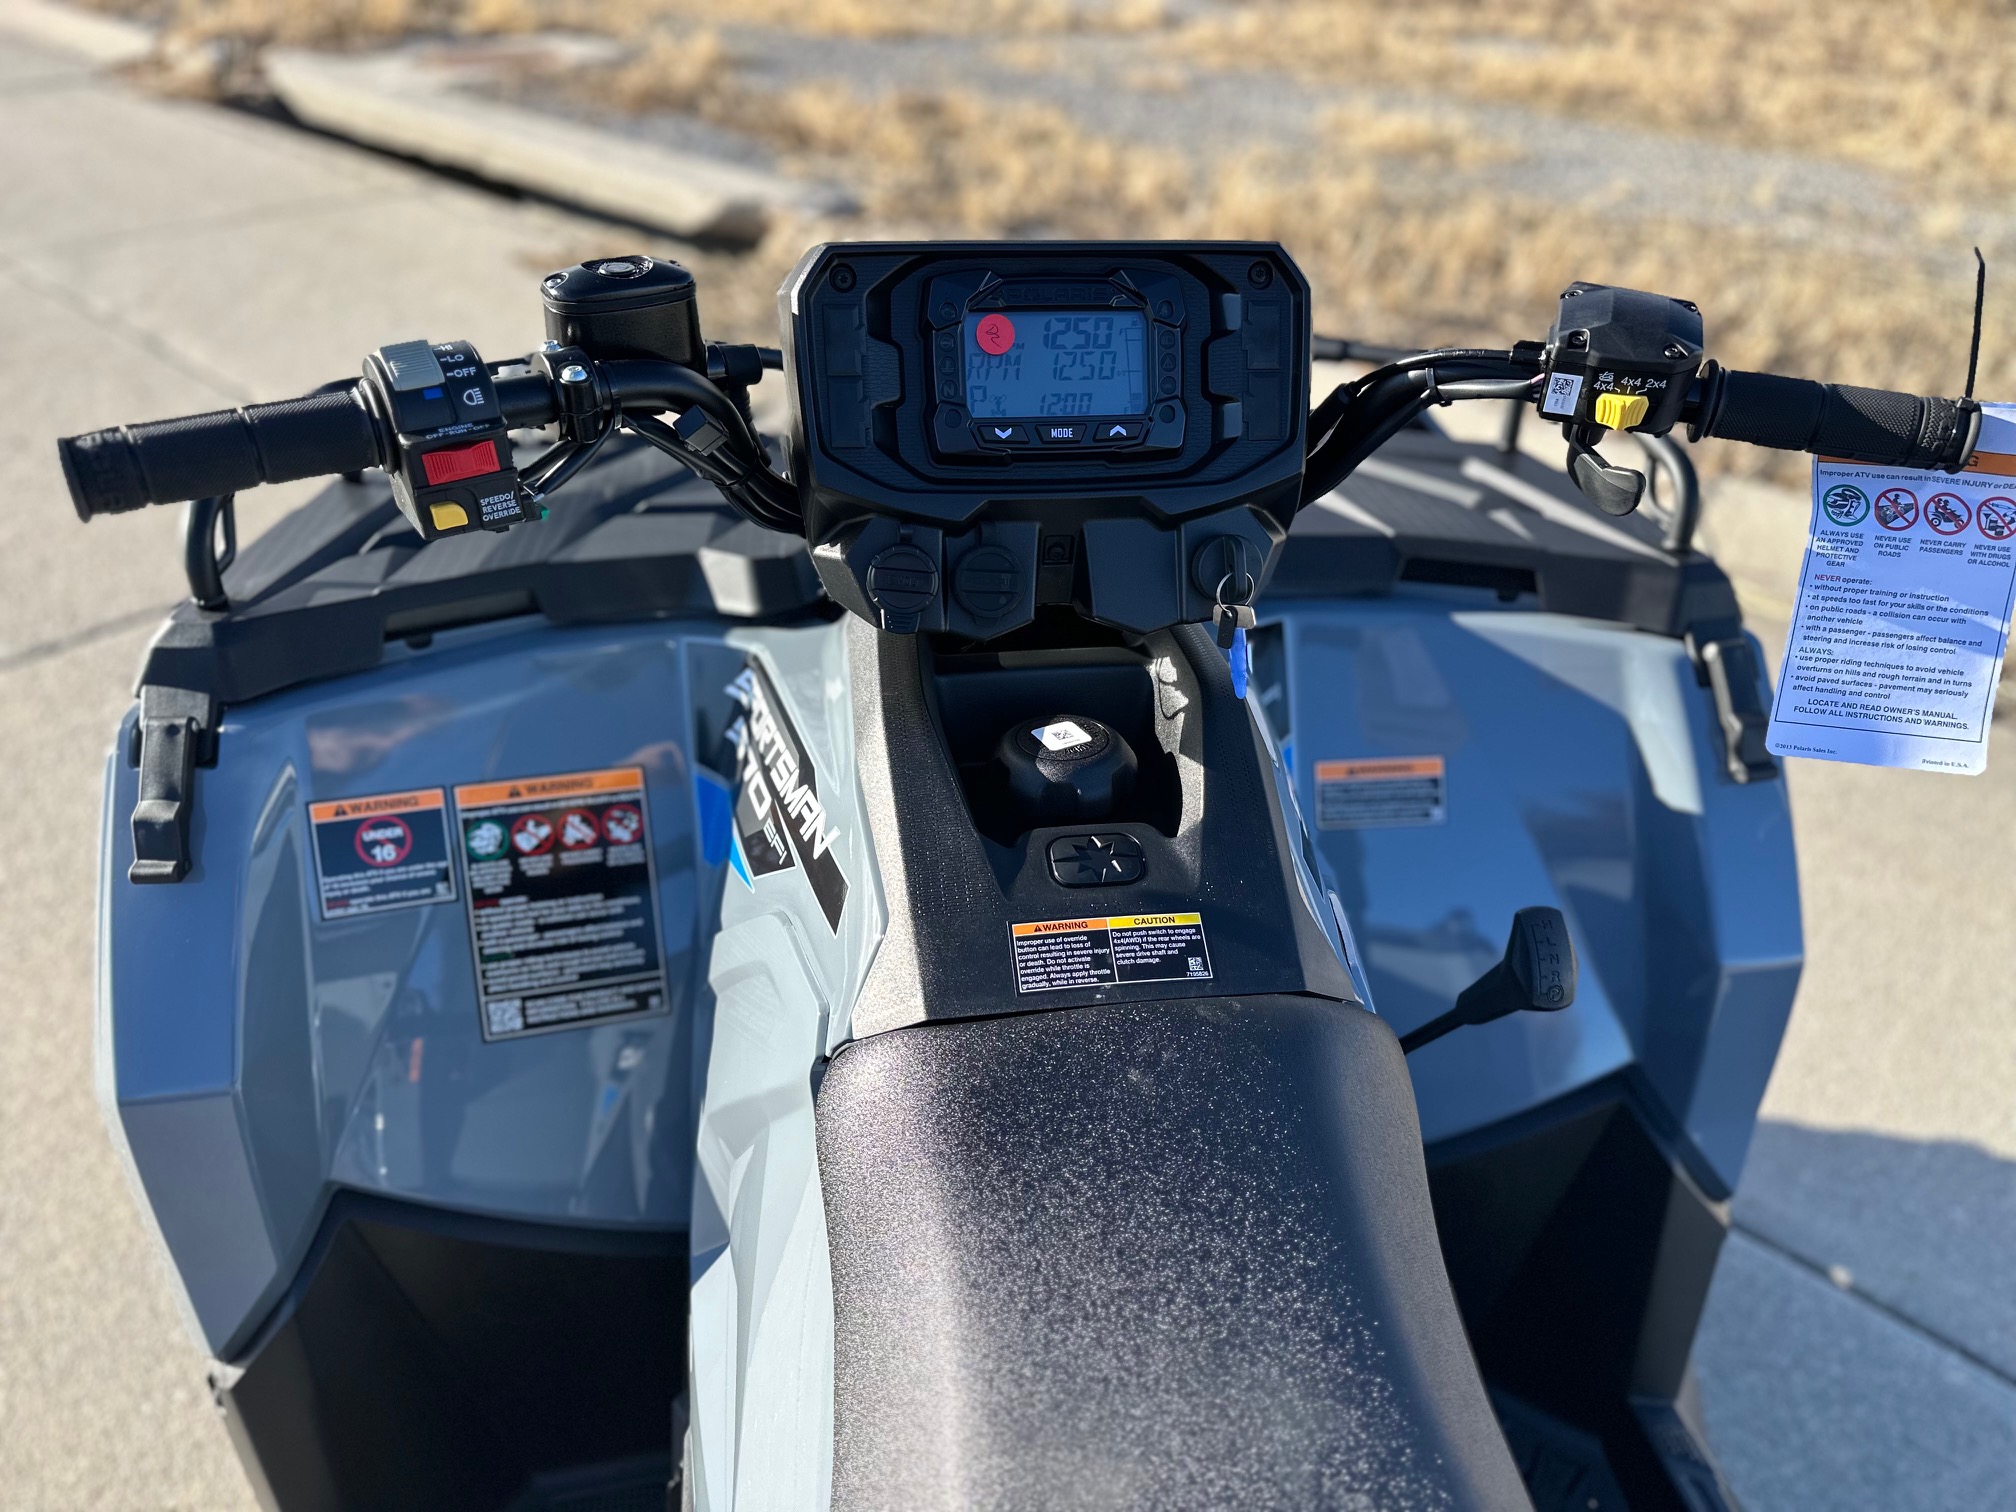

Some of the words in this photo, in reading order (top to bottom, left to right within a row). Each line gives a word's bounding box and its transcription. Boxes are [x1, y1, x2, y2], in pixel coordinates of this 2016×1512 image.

[1043, 317, 1114, 350] 1250
[967, 352, 1022, 381] RPM
[1053, 351, 1116, 380] 1250
[438, 423, 473, 433] ENGINE
[1051, 428, 1073, 438] MODE
[1932, 476, 1961, 485] SEVERE
[1962, 479, 1993, 488] INJURY
[480, 490, 514, 506] SPEEDO/
[482, 500, 517, 514] REVERSE
[482, 506, 521, 521] OVERRIDE
[1814, 574, 1841, 582] NEVER
[1869, 589, 1898, 599] training
[1909, 592, 1949, 602] instruction
[1879, 611, 1910, 619] collision
[1949, 608, 1989, 616] conditions
[1828, 627, 1866, 636] passenger
[1872, 632, 1914, 640] passengers
[1938, 636, 1966, 645] balance
[1798, 646, 1834, 656] ALWAYS:
[1840, 658, 1862, 668] riding
[1864, 661, 1904, 670] techniques
[1878, 684, 1916, 692] pavement
[1934, 689, 1969, 698] seriously
[1808, 698, 1839, 708] LOCATE
[1859, 704, 1882, 712] READ
[1883, 706, 1920, 716] OWNER'S
[1922, 710, 1958, 720] MANUAL.
[1794, 706, 1827, 715] FOLLOW
[1845, 711, 1903, 723] INSTRUCTIONS
[1924, 719, 1969, 730] WARNINGS.
[526, 777, 593, 794] WARNING
[351, 796, 419, 814] WARNING
[763, 818, 787, 865] EFI
[371, 844, 396, 862] 16
[1042, 921, 1088, 931] WARNING
[1134, 916, 1175, 925] CAUTION
